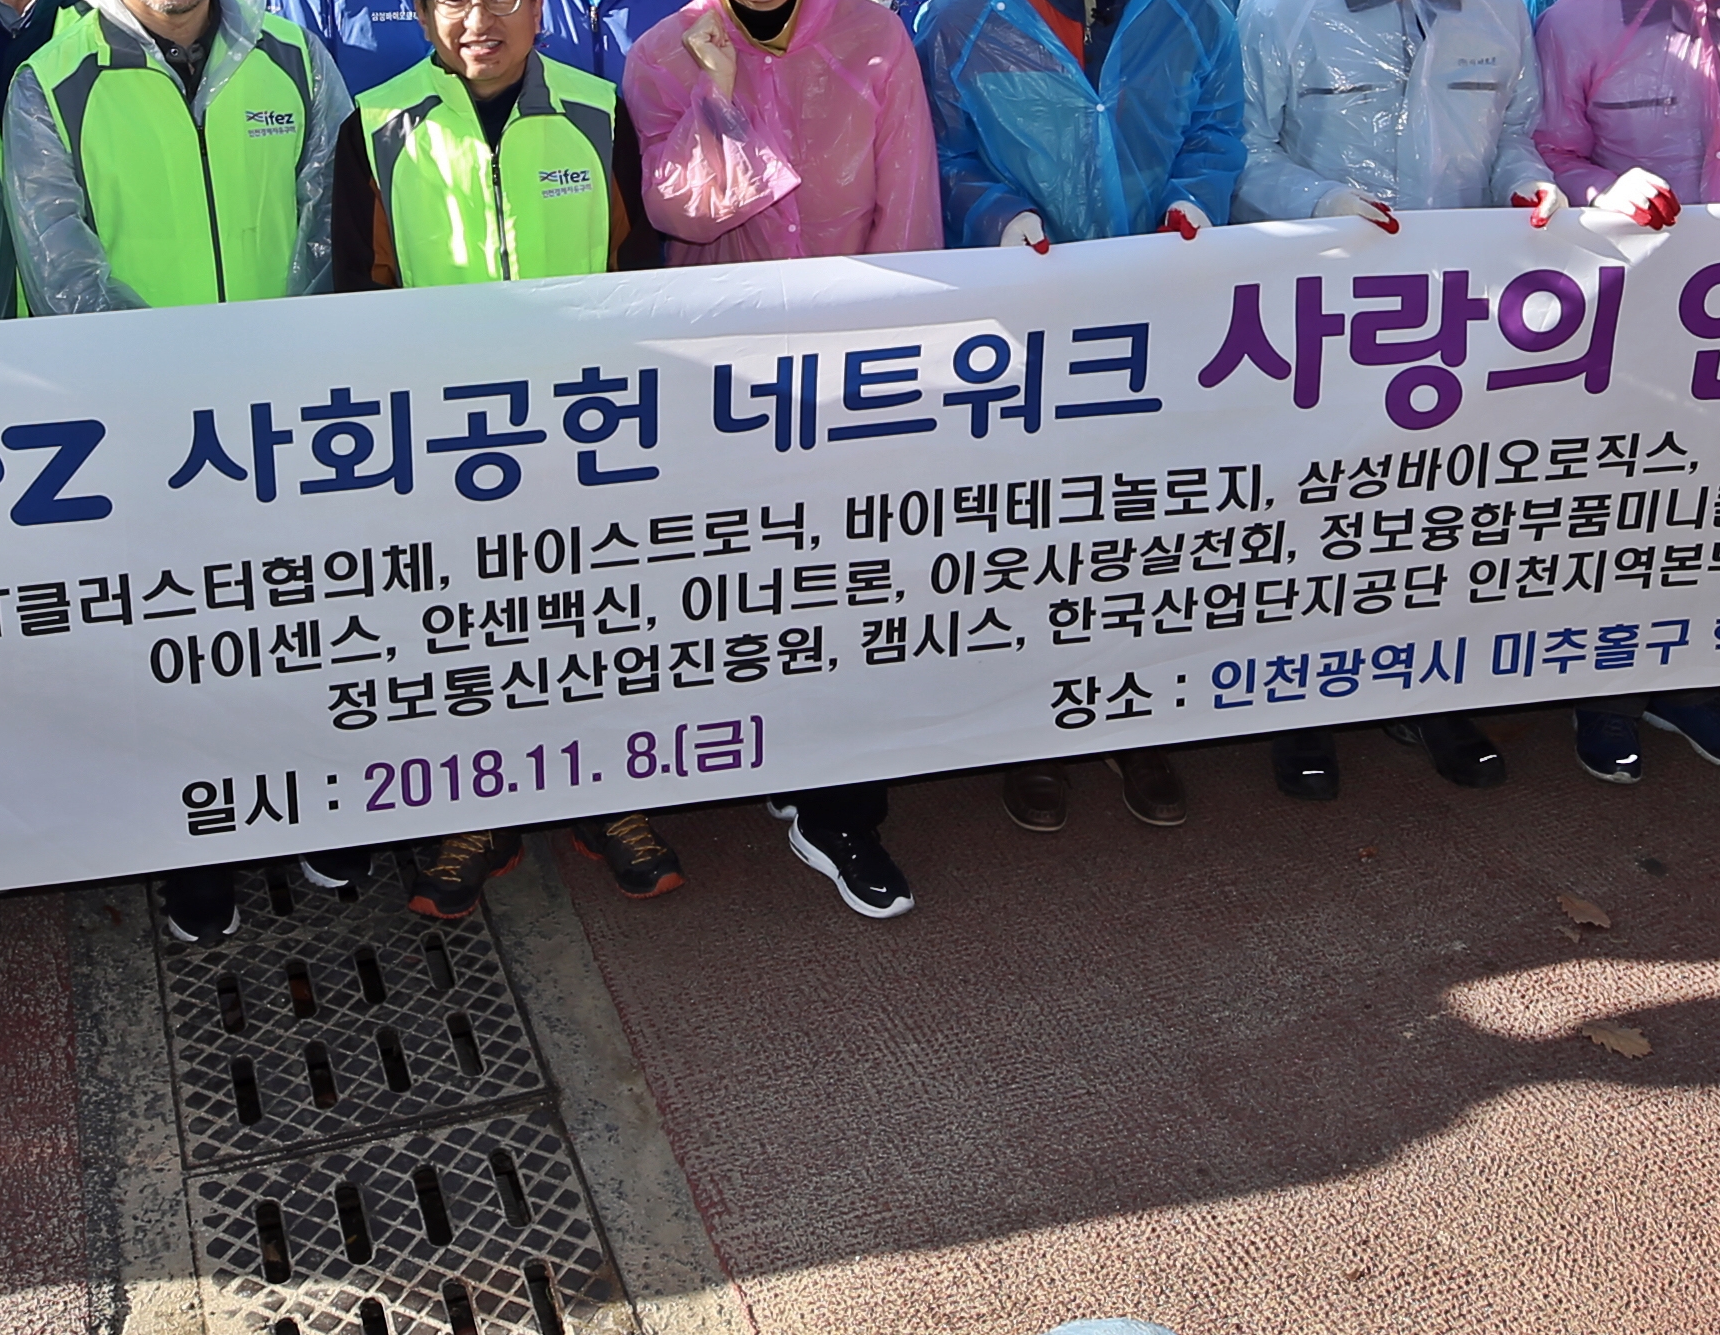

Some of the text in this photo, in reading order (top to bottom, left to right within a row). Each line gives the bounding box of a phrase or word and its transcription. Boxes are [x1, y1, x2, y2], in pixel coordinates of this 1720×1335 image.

[264, 110, 295, 126] ifez
[557, 169, 591, 185] ifez
[168, 366, 661, 504] 사회공헌
[712, 322, 1163, 452] 네트워크
[1197, 266, 1625, 431] 사랑의
[477, 500, 821, 583] 바이스트로닉,
[846, 465, 1275, 544] 바이텍테크놀로지,
[1297, 428, 1700, 503] 삼성바이오로직스,
[150, 615, 397, 688] 아이센스,
[423, 583, 658, 656] 얀센백신,
[682, 560, 906, 624] 이너트론,
[930, 521, 1296, 600] 이웃사랑실천회,
[328, 626, 838, 731] 정보통신산업진흥원,
[862, 607, 1026, 667] 캠시스,
[1048, 565, 1447, 644] 한국산업단지공단
[1051, 674, 1154, 731] 장소
[1211, 636, 1467, 711] 인천광역시
[1491, 619, 1691, 679] 미추홀구
[181, 769, 300, 836] 일시
[364, 739, 603, 812] 2018.11.
